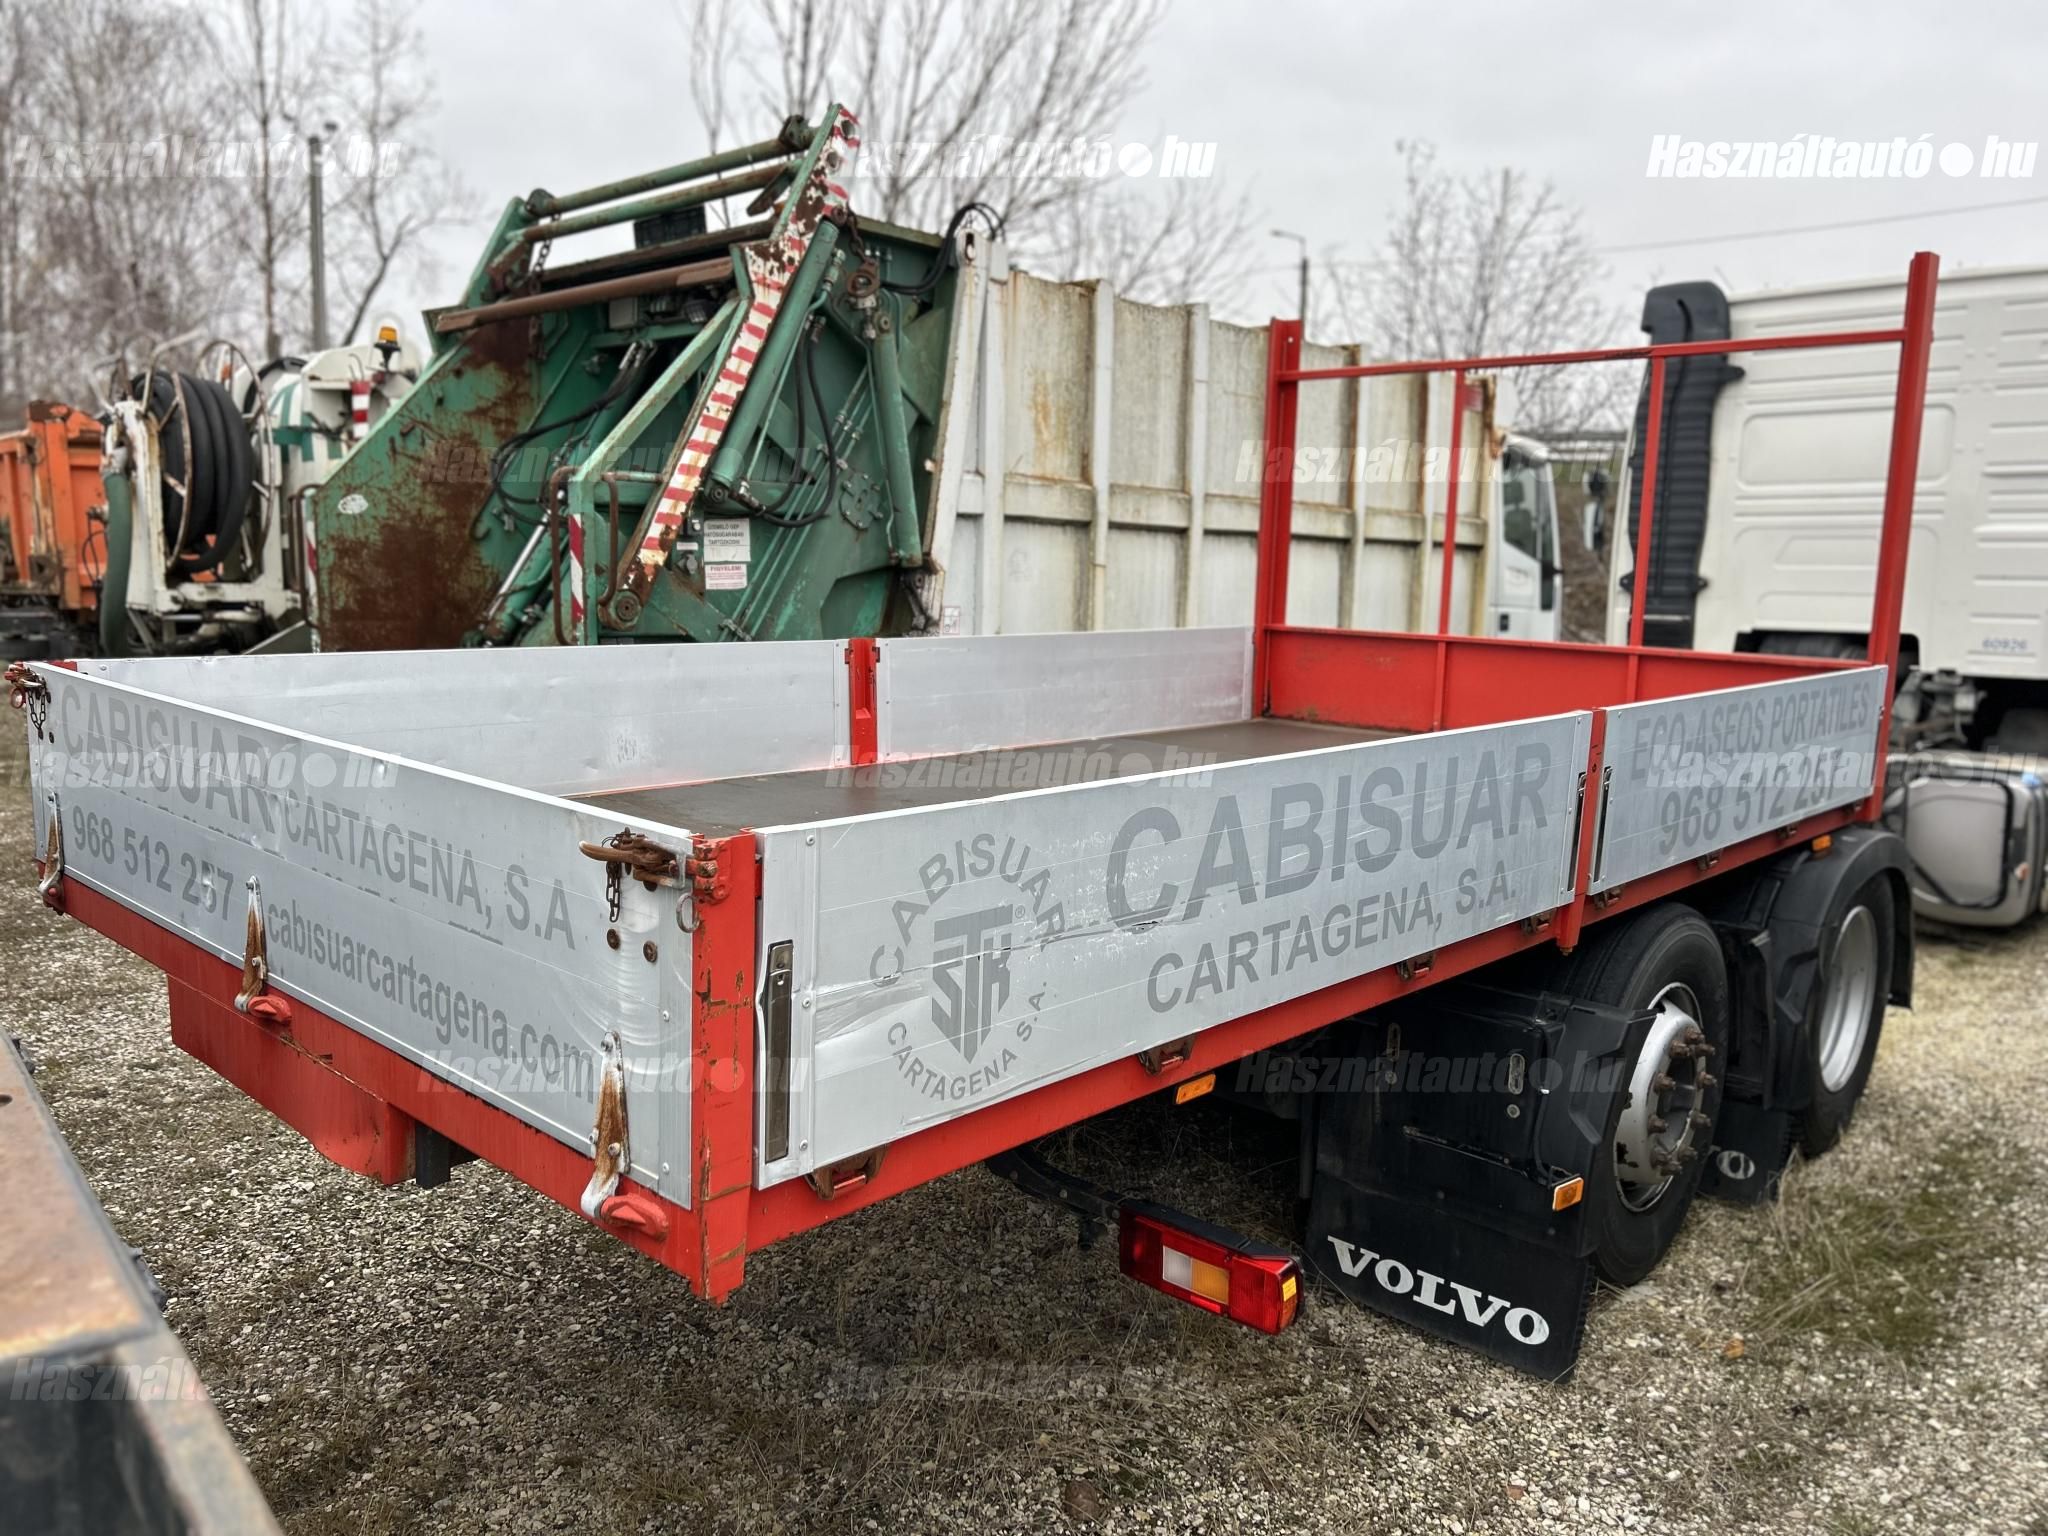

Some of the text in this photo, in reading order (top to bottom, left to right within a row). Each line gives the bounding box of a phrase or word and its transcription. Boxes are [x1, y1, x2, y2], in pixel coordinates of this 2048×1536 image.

[61, 685, 276, 834] CABISUAR
[1631, 682, 1871, 780] ECO-ASEOS PORTATILES
[73, 805, 234, 921] 968 512 257
[284, 789, 493, 930] CARTAGENA,
[1106, 742, 1552, 933] CABISUAR
[1660, 781, 1723, 855] 968
[1733, 764, 1785, 831] 512
[869, 833, 1066, 988] CABISUAR
[1147, 860, 1516, 1013] CARTAGENA, S.A.
[268, 900, 595, 1104] cabisuarcartagena.com
[887, 981, 1048, 1101] CARTAGENA S.A.
[1327, 1235, 1549, 1345] VOLVO
